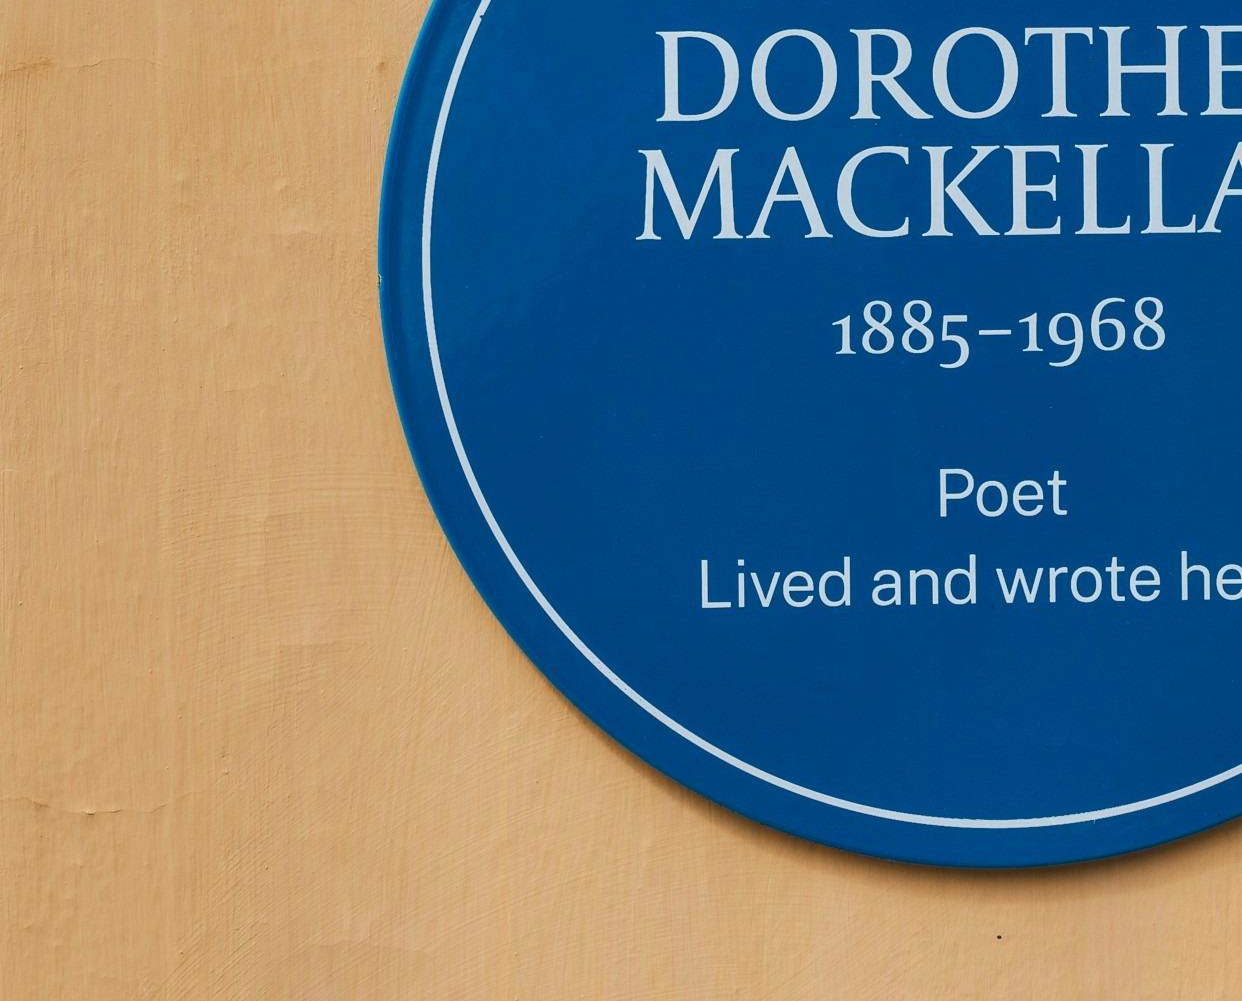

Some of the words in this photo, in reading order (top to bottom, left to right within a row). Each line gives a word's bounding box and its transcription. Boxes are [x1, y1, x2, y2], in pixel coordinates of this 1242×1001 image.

[938, 468, 1068, 518] Poet
[700, 552, 852, 610] Lived
[871, 553, 977, 607] and
[995, 556, 1162, 605] wrote
